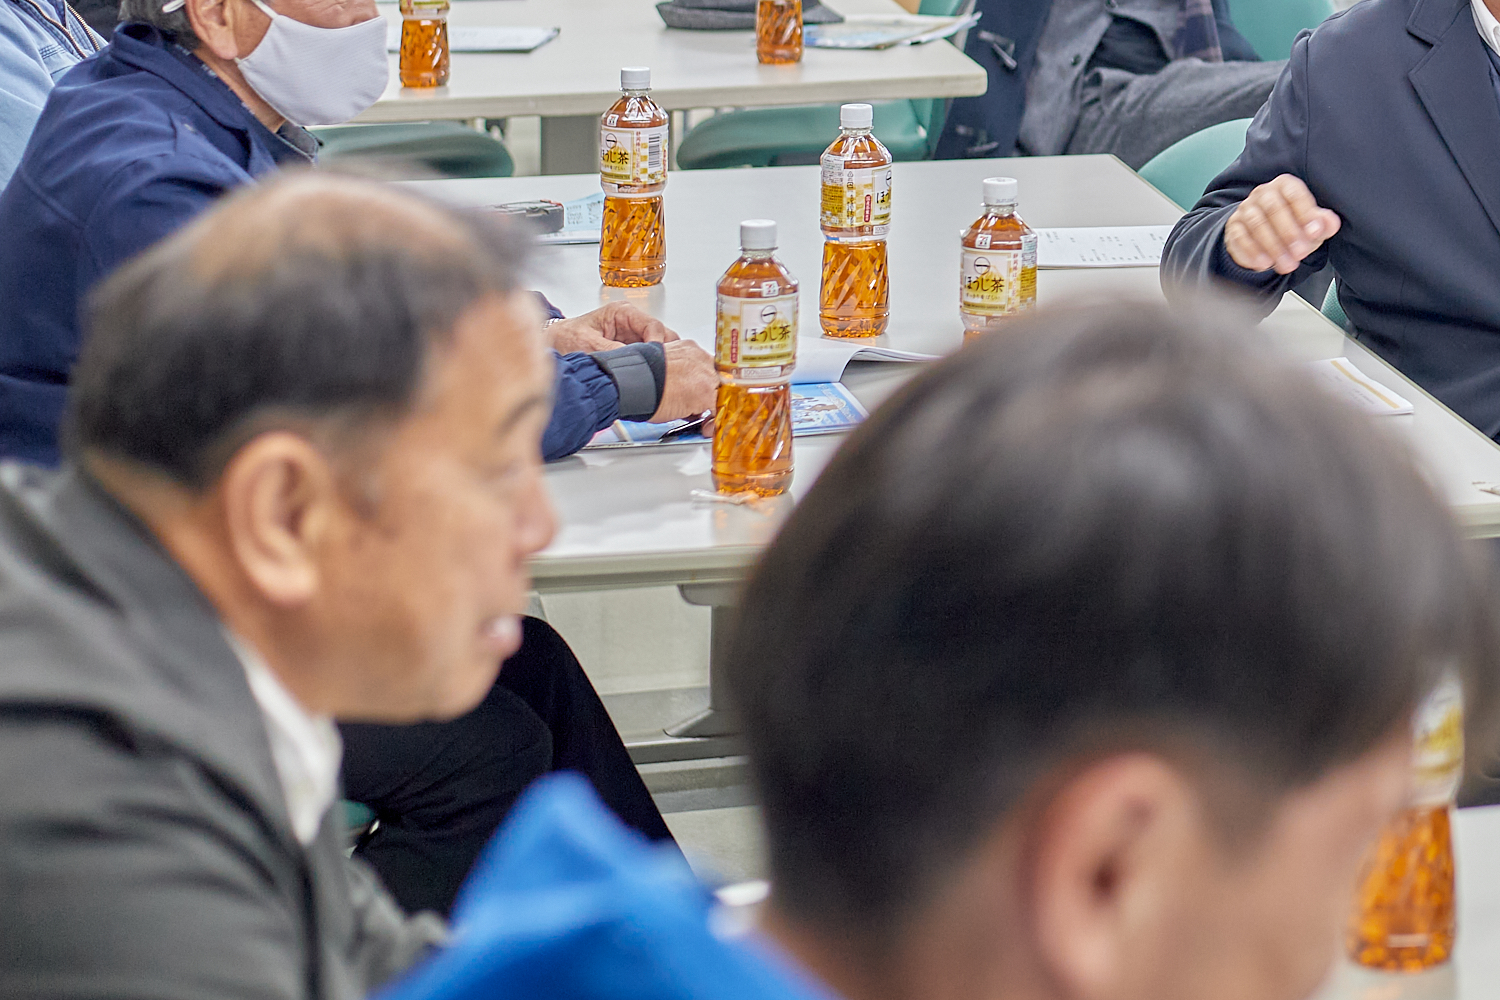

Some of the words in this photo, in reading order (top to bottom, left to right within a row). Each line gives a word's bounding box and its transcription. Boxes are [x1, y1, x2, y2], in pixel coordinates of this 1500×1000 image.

[965, 276, 1005, 293] ほうじ茶
[744, 324, 791, 342] ほうじ茶
